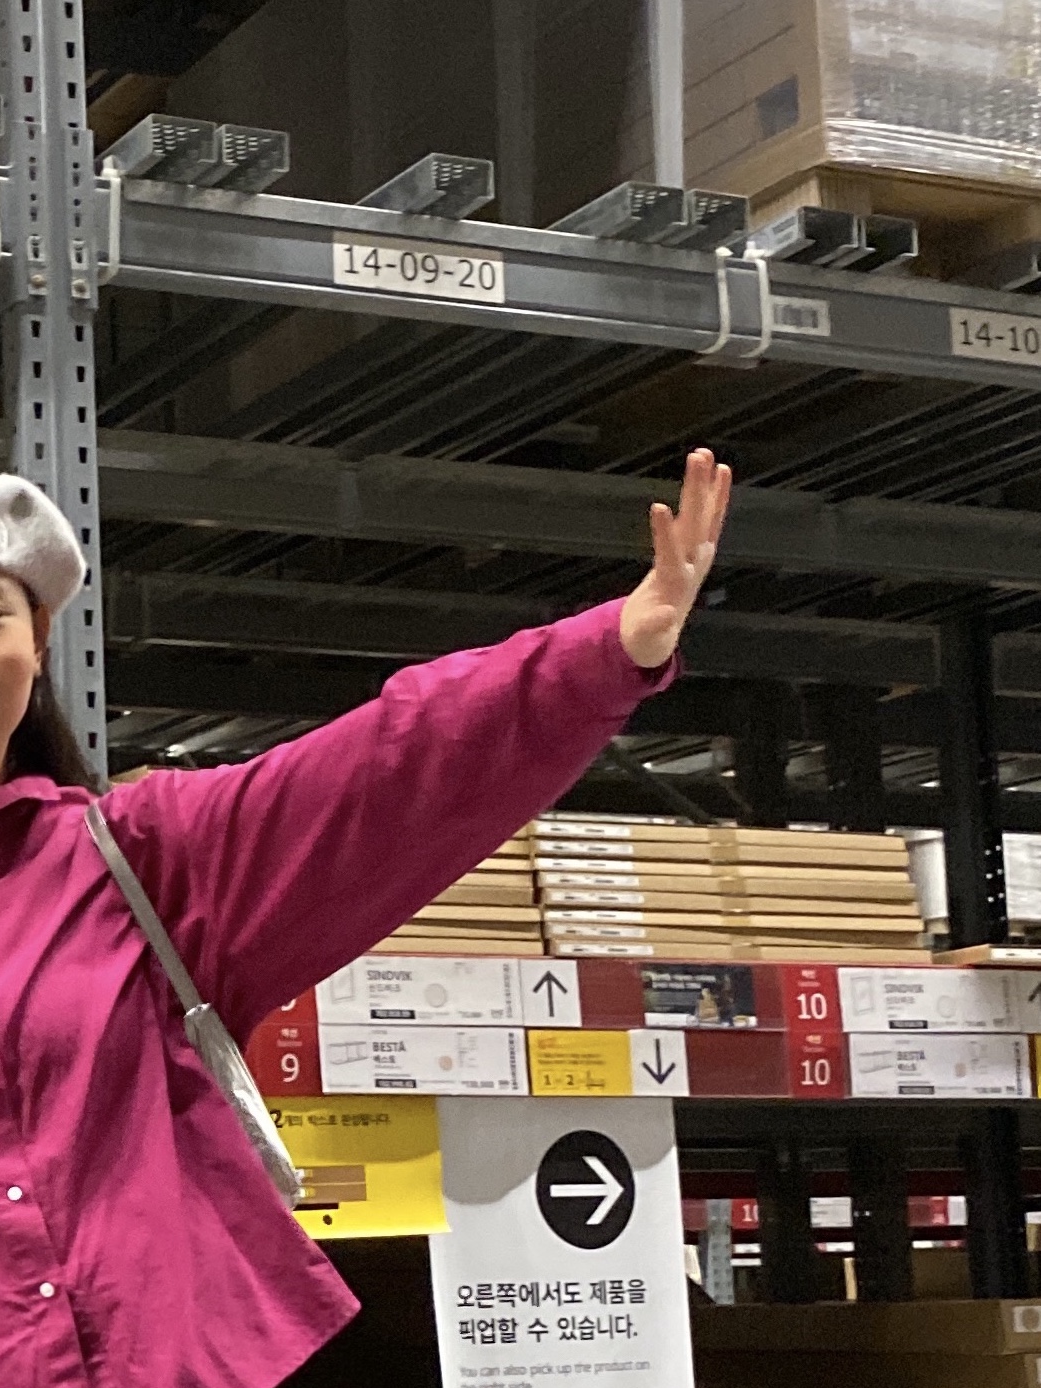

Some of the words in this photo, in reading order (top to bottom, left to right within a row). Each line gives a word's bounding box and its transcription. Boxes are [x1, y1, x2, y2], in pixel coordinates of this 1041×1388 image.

[343, 245, 496, 291] 14-09-20
[796, 992, 828, 1020] 10
[280, 1053, 299, 1083] 9
[801, 1059, 831, 1086] 10
[456, 1281, 583, 1309] 오른쪽에서도
[589, 1278, 647, 1305] 제품을
[458, 1317, 518, 1344] 픽업할
[527, 1317, 549, 1343] 수
[557, 1313, 639, 1342] 있습니다.
[479, 1367, 500, 1377] can
[503, 1364, 527, 1376] also
[530, 1362, 554, 1377] pick
[557, 1364, 572, 1376] up
[594, 1360, 634, 1375] product
